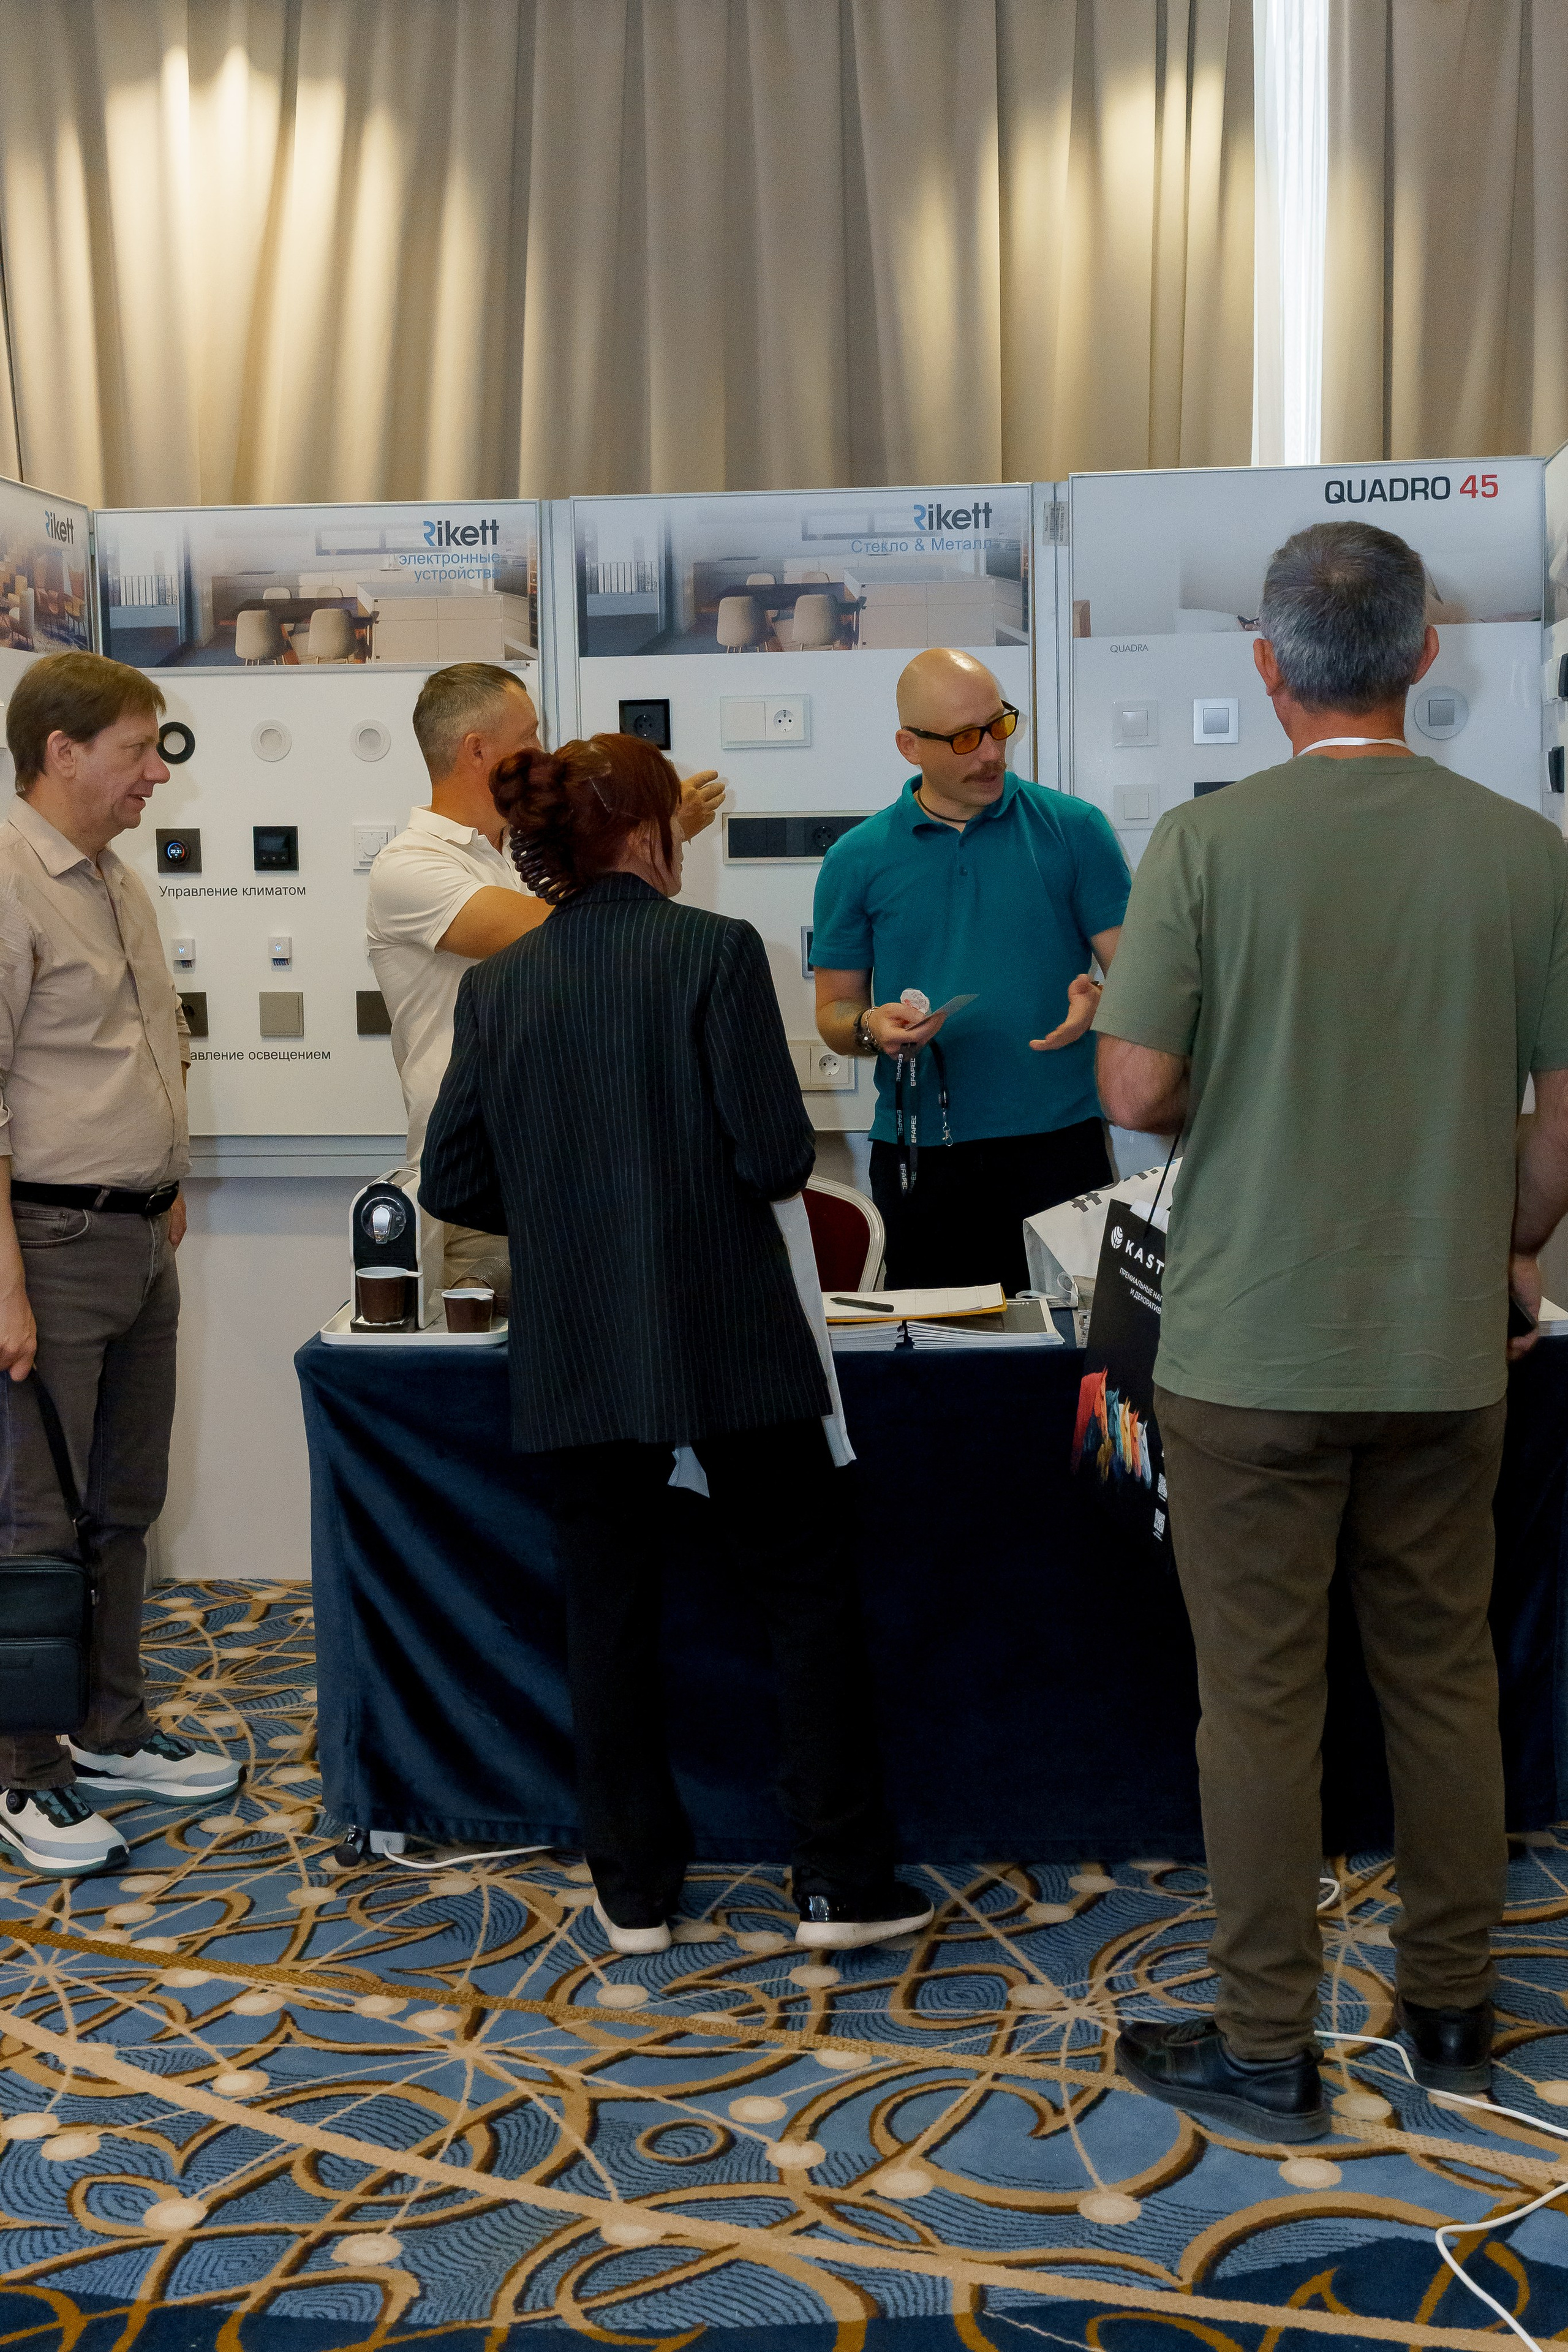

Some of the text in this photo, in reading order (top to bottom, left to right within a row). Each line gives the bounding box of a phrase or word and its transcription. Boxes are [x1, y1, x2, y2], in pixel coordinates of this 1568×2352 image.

[1324, 474, 1499, 504] QUADRO 45
[45, 510, 74, 545] Rikett
[913, 502, 992, 530] Rikett
[423, 519, 499, 546] Rikett
[851, 537, 992, 553] Стекло & Металл
[399, 552, 501, 567] электронные
[414, 566, 502, 583] устройства
[1110, 644, 1149, 654] QUADRA
[159, 886, 306, 900] Управление климатом
[190, 1050, 331, 1062] авление освещением
[900, 1163, 908, 1190] EFAPEL
[1125, 1239, 1165, 1275] KAST
[1119, 1267, 1153, 1297] ПРЕМИАЛЬНЫЕ
[1133, 1291, 1162, 1315] ДЕКОРАТИВ
